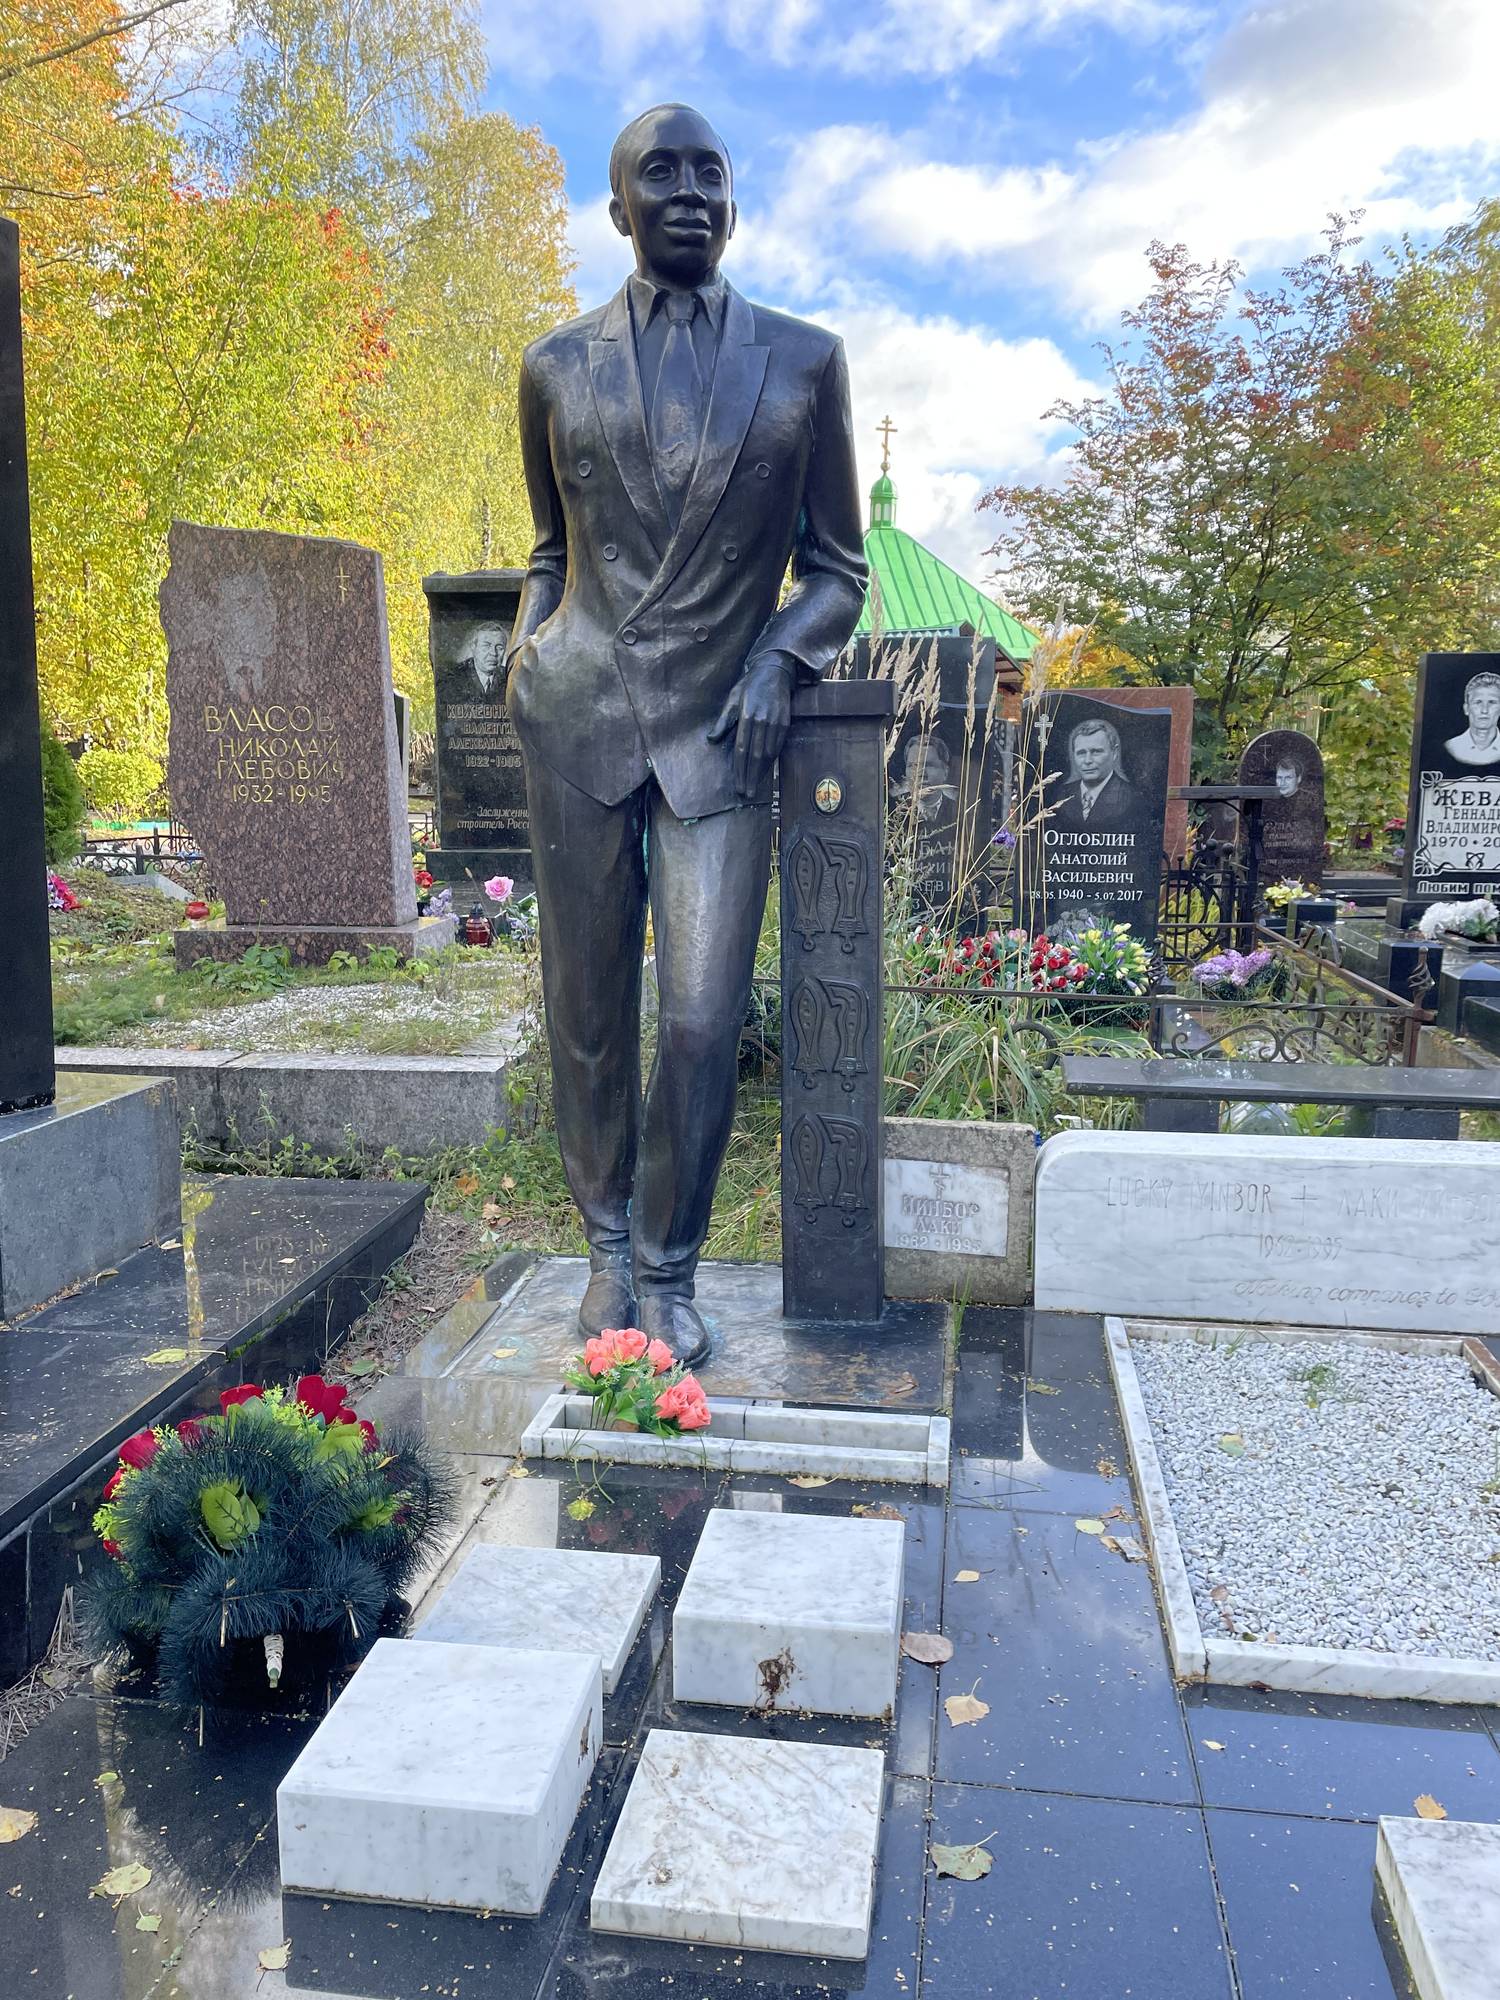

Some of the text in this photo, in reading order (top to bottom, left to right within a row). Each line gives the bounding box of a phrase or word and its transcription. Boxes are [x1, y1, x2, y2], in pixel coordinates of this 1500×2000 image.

[204, 704, 335, 732] ВЛАСОВ
[218, 735, 340, 757] НИКОЛАЙ
[216, 760, 345, 780] ГЛЕБОВИЧ
[1044, 830, 1136, 847] ОГЛОБЛИН
[1050, 852, 1128, 866] АНАТОЛИЙ
[1042, 870, 1134, 884] ВАСИЛЬЕВИЧ
[1107, 1177, 1173, 1208] LUCKY
